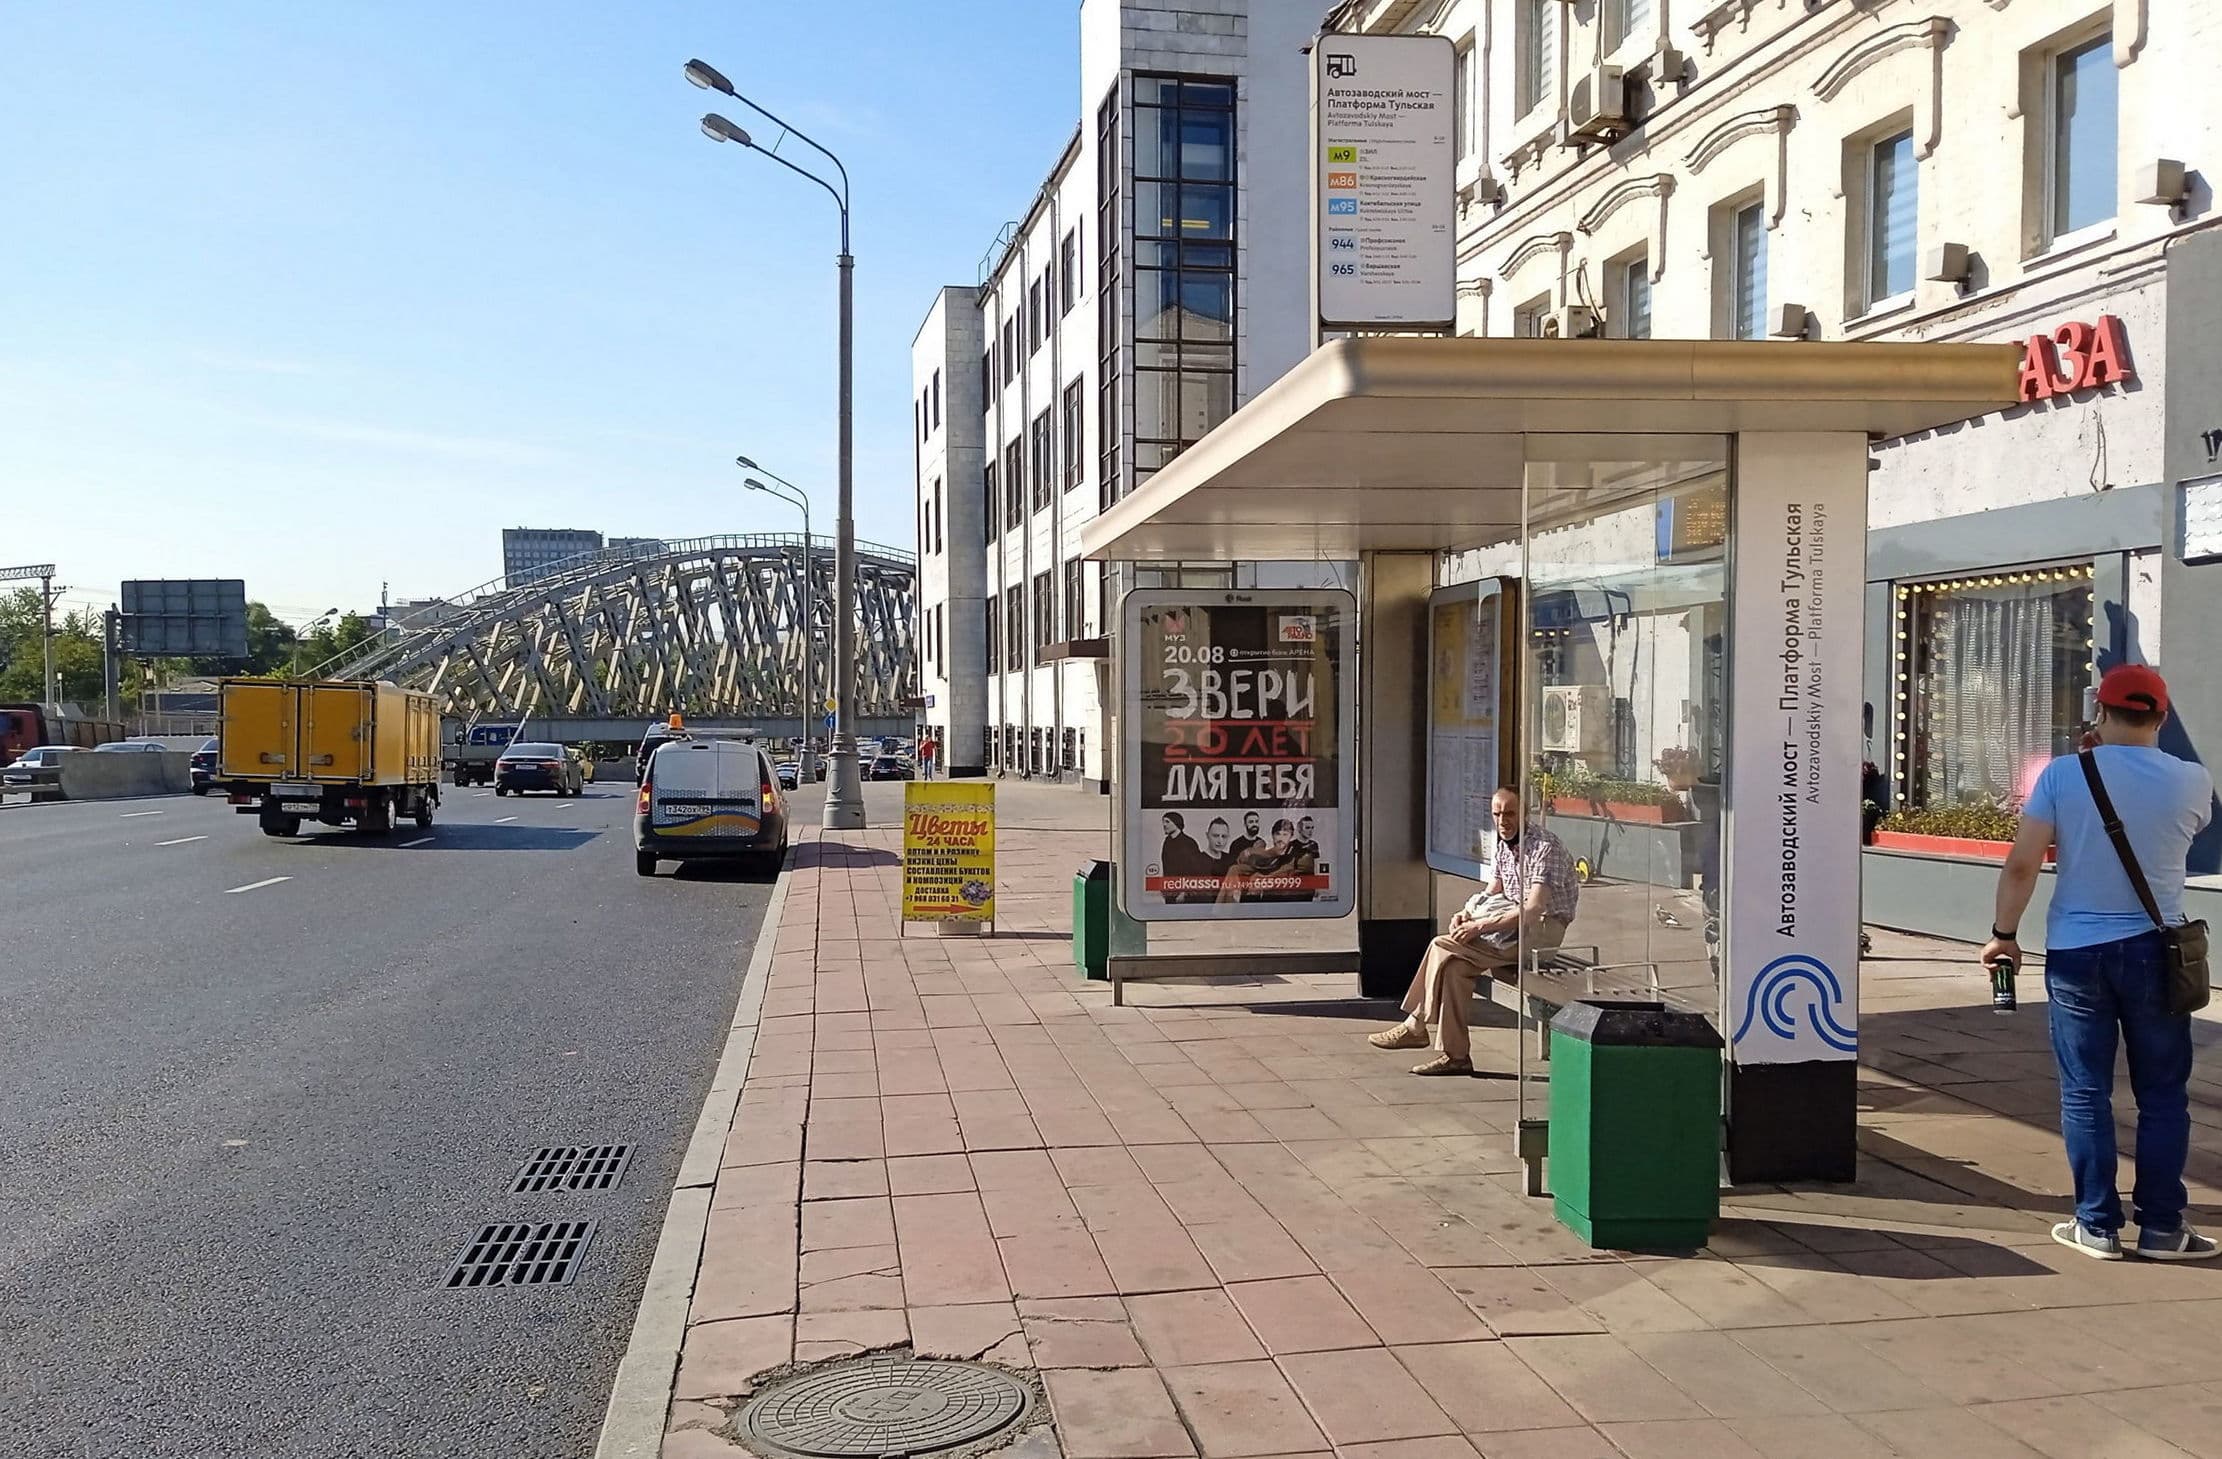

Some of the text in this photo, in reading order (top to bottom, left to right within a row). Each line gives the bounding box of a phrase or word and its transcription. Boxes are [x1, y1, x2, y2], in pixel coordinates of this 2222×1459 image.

[1327, 88, 1404, 99] Автозаводский
[1406, 91, 1430, 99] мост
[1327, 99, 1435, 111] Платформа Тульская
[1332, 239, 1354, 249] 944
[1332, 264, 1354, 275] 965
[2009, 313, 2132, 403] АЗА
[1781, 503, 1805, 593] Тульская
[1809, 503, 1828, 565] Tulskaya
[1808, 569, 1823, 640] Platforma
[1164, 646, 1225, 663] 20.08
[1288, 648, 1316, 656] АРЕНА
[1779, 599, 1804, 711] Платформа
[1163, 668, 1315, 719] ЗВЕРИ
[1808, 661, 1822, 698] Most
[1164, 726, 1314, 756] 20 ЛЕТ
[1806, 701, 1825, 804] Avtozavodskiy
[1783, 741, 1798, 787] мост
[1162, 764, 1315, 801] ДЛЯ ТЕБЯ
[909, 813, 988, 840] Цветы
[926, 836, 976, 846] 24 ЧАСА
[906, 867, 957, 875] СОСТАВЛЕНИЕ
[1776, 793, 1799, 938] Автозаводский
[1254, 877, 1302, 889] 6659999
